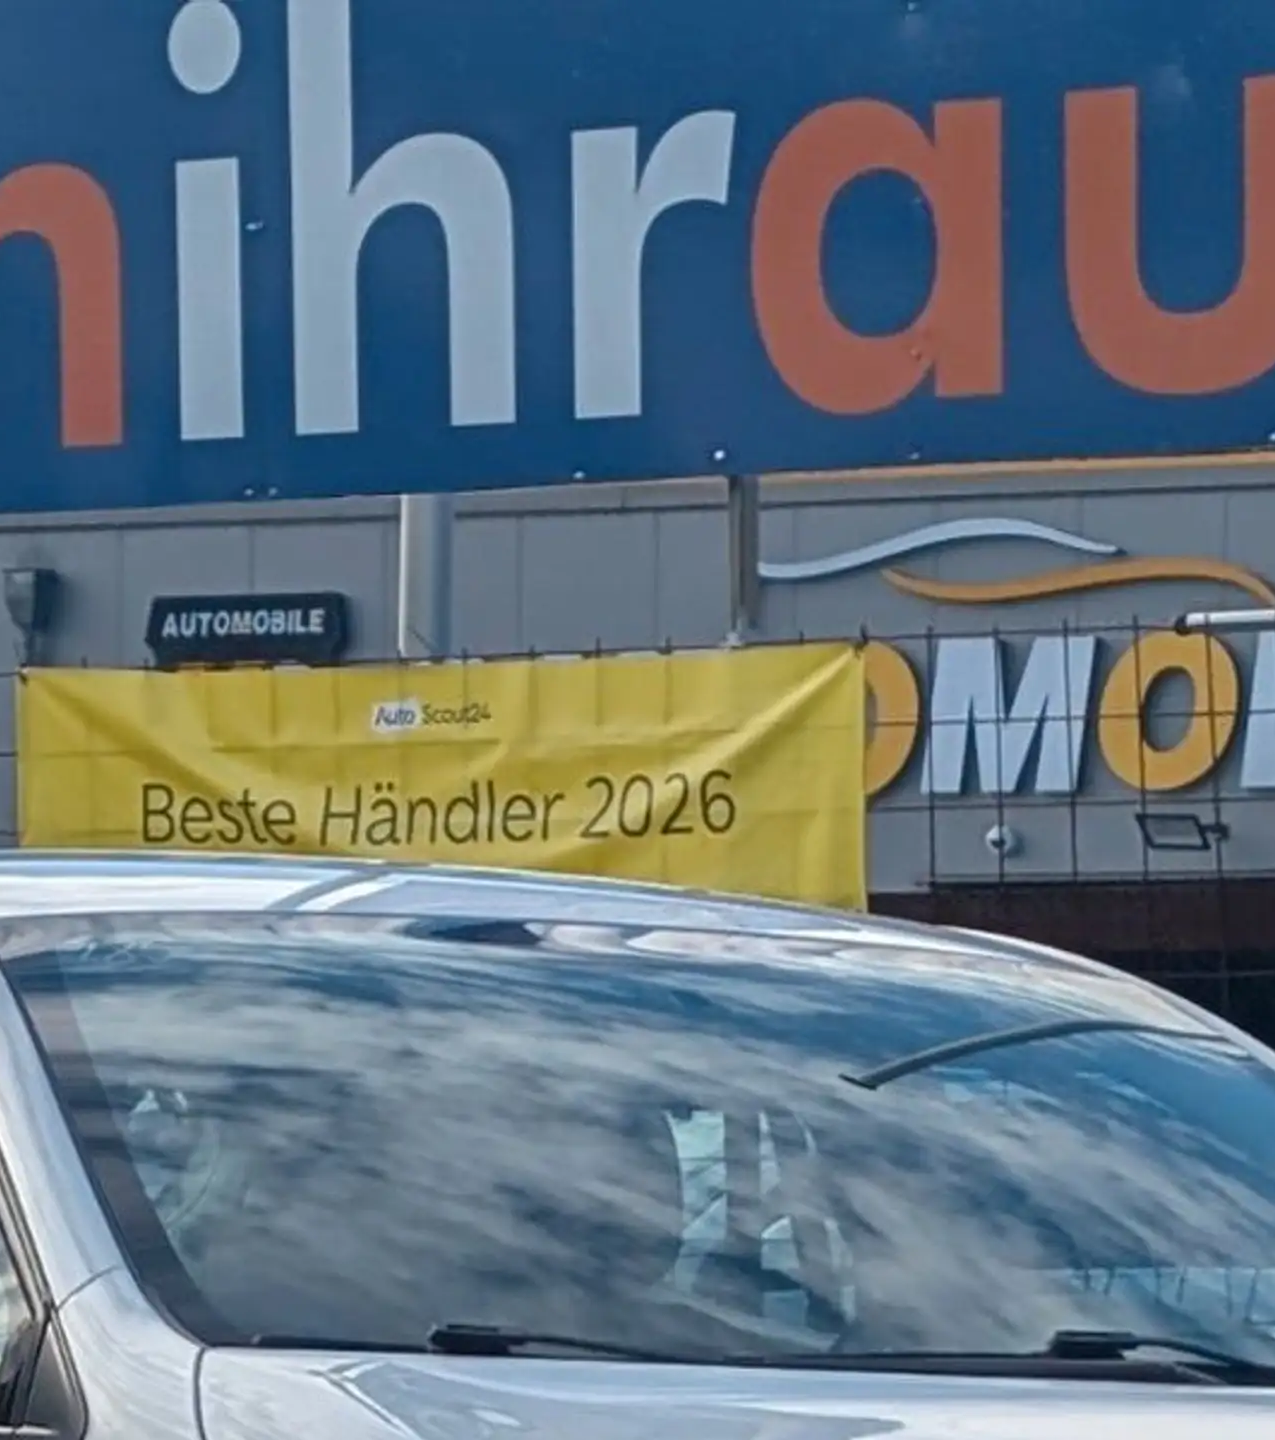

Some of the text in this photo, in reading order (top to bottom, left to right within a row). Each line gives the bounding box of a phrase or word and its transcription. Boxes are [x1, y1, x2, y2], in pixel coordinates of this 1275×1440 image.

[162, 608, 326, 638] AUTOMOBILE
[141, 768, 738, 848] Beste Händler 2026
